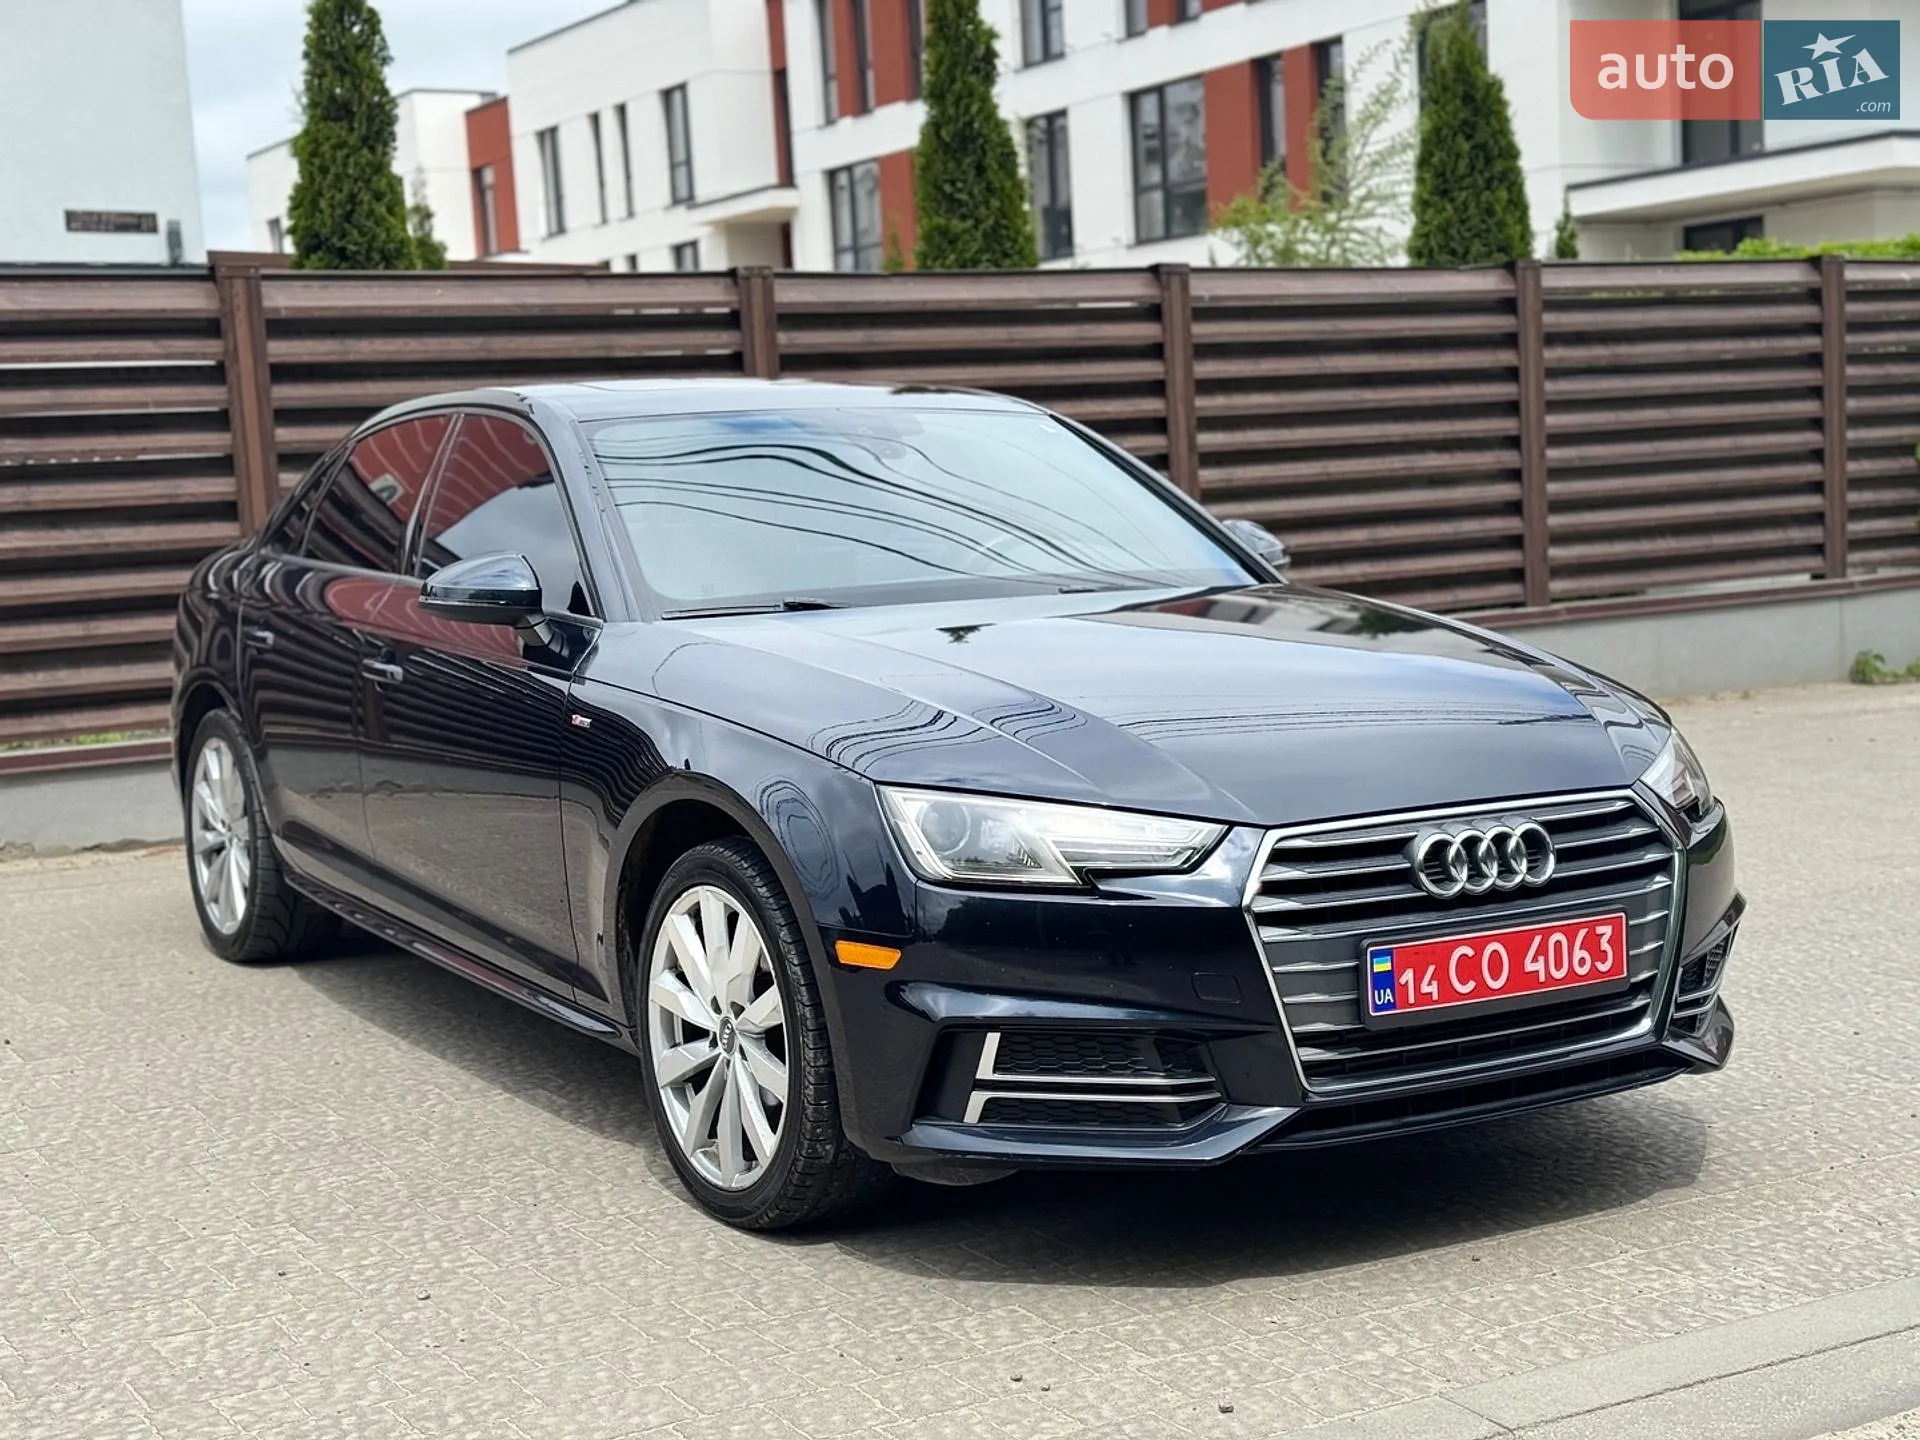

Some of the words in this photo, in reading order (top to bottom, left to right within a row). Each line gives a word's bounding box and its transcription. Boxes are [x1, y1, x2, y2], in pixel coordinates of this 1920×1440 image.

[1399, 964, 1439, 1005] 14
[1449, 941, 1510, 995] CO
[1524, 925, 1614, 984] 4063
[1374, 987, 1394, 1005] UA
